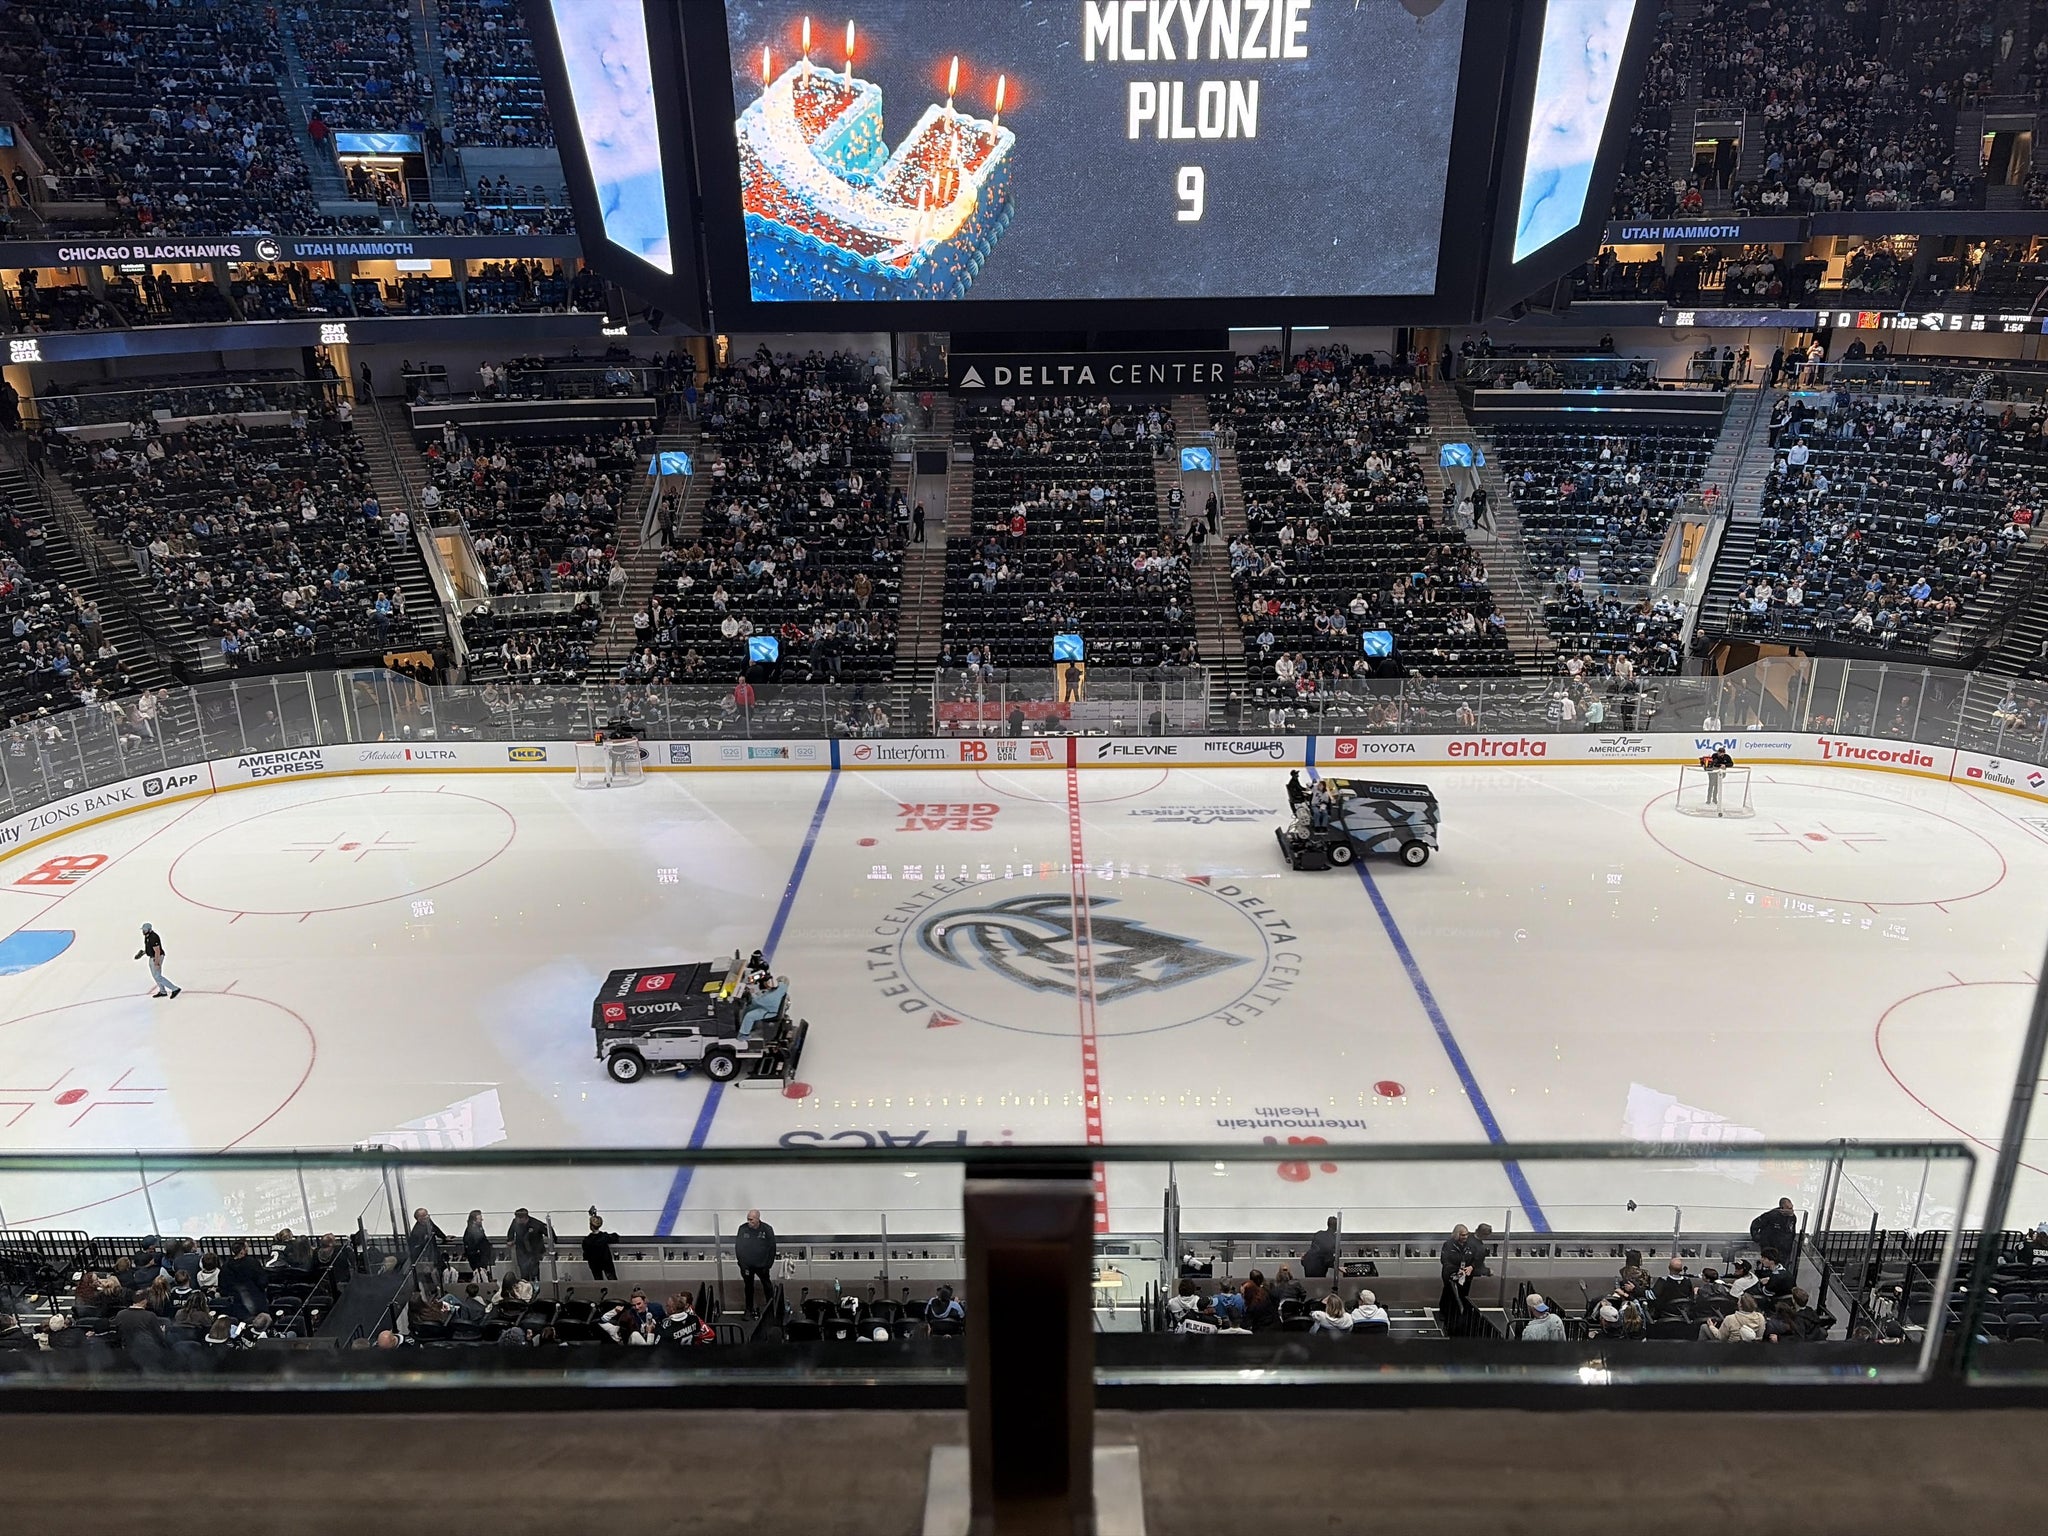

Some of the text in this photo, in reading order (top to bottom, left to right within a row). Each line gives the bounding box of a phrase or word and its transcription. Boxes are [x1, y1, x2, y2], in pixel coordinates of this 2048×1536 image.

[1083, 0, 1309, 62] MCKYNZIE
[1128, 80, 1258, 140] PILON
[1176, 166, 1205, 222] 9
[1621, 226, 1740, 240] UTAH MAMMOTH
[58, 244, 242, 262] CHICAGO BLACKHAWKS
[294, 243, 414, 256] UTAH MAMMOTH
[1676, 318, 1695, 326] GEEK
[1677, 311, 1696, 319] SEAT
[320, 323, 347, 335] SEAT
[1882, 317, 1918, 330] 11:02
[1950, 315, 1963, 331] 5
[10, 339, 38, 352] SEAT
[321, 333, 350, 344] GEEK
[10, 350, 43, 363] GEEK
[993, 363, 1225, 385] DELTA CENTER
[1547, 706, 1560, 718] 25
[876, 744, 946, 761] Interform
[960, 741, 988, 761] PB
[1113, 744, 1177, 755] FILEVINE
[1362, 743, 1416, 753] TOYOTA
[1447, 738, 1547, 757] entrata
[1588, 745, 1652, 753] AMERICA FIRST
[1744, 741, 1792, 750] Cybersecurity
[237, 749, 321, 769] AMERICAN
[359, 749, 457, 762] Michelob ULTRA
[511, 748, 545, 760] IKEA
[997, 753, 1017, 761] GOAL
[1833, 741, 1934, 767] Trucordia
[251, 760, 325, 778] EXPRESS
[1984, 770, 2016, 786] YouTube
[28, 787, 136, 831] ZIONS BANK
[896, 803, 1001, 817] GEEK
[895, 817, 994, 832] SEAT
[0, 825, 20, 845] ity
[866, 876, 975, 1014] DELTA CENTER
[1213, 885, 1303, 1027] DELTA CENTER
[616, 972, 638, 998] TOYOTA
[628, 1001, 683, 1016] TOYOTA
[1255, 1106, 1320, 1118] Health
[1216, 1118, 1368, 1130] Intermountain
[1185, 1322, 1211, 1334] WILDCARD
